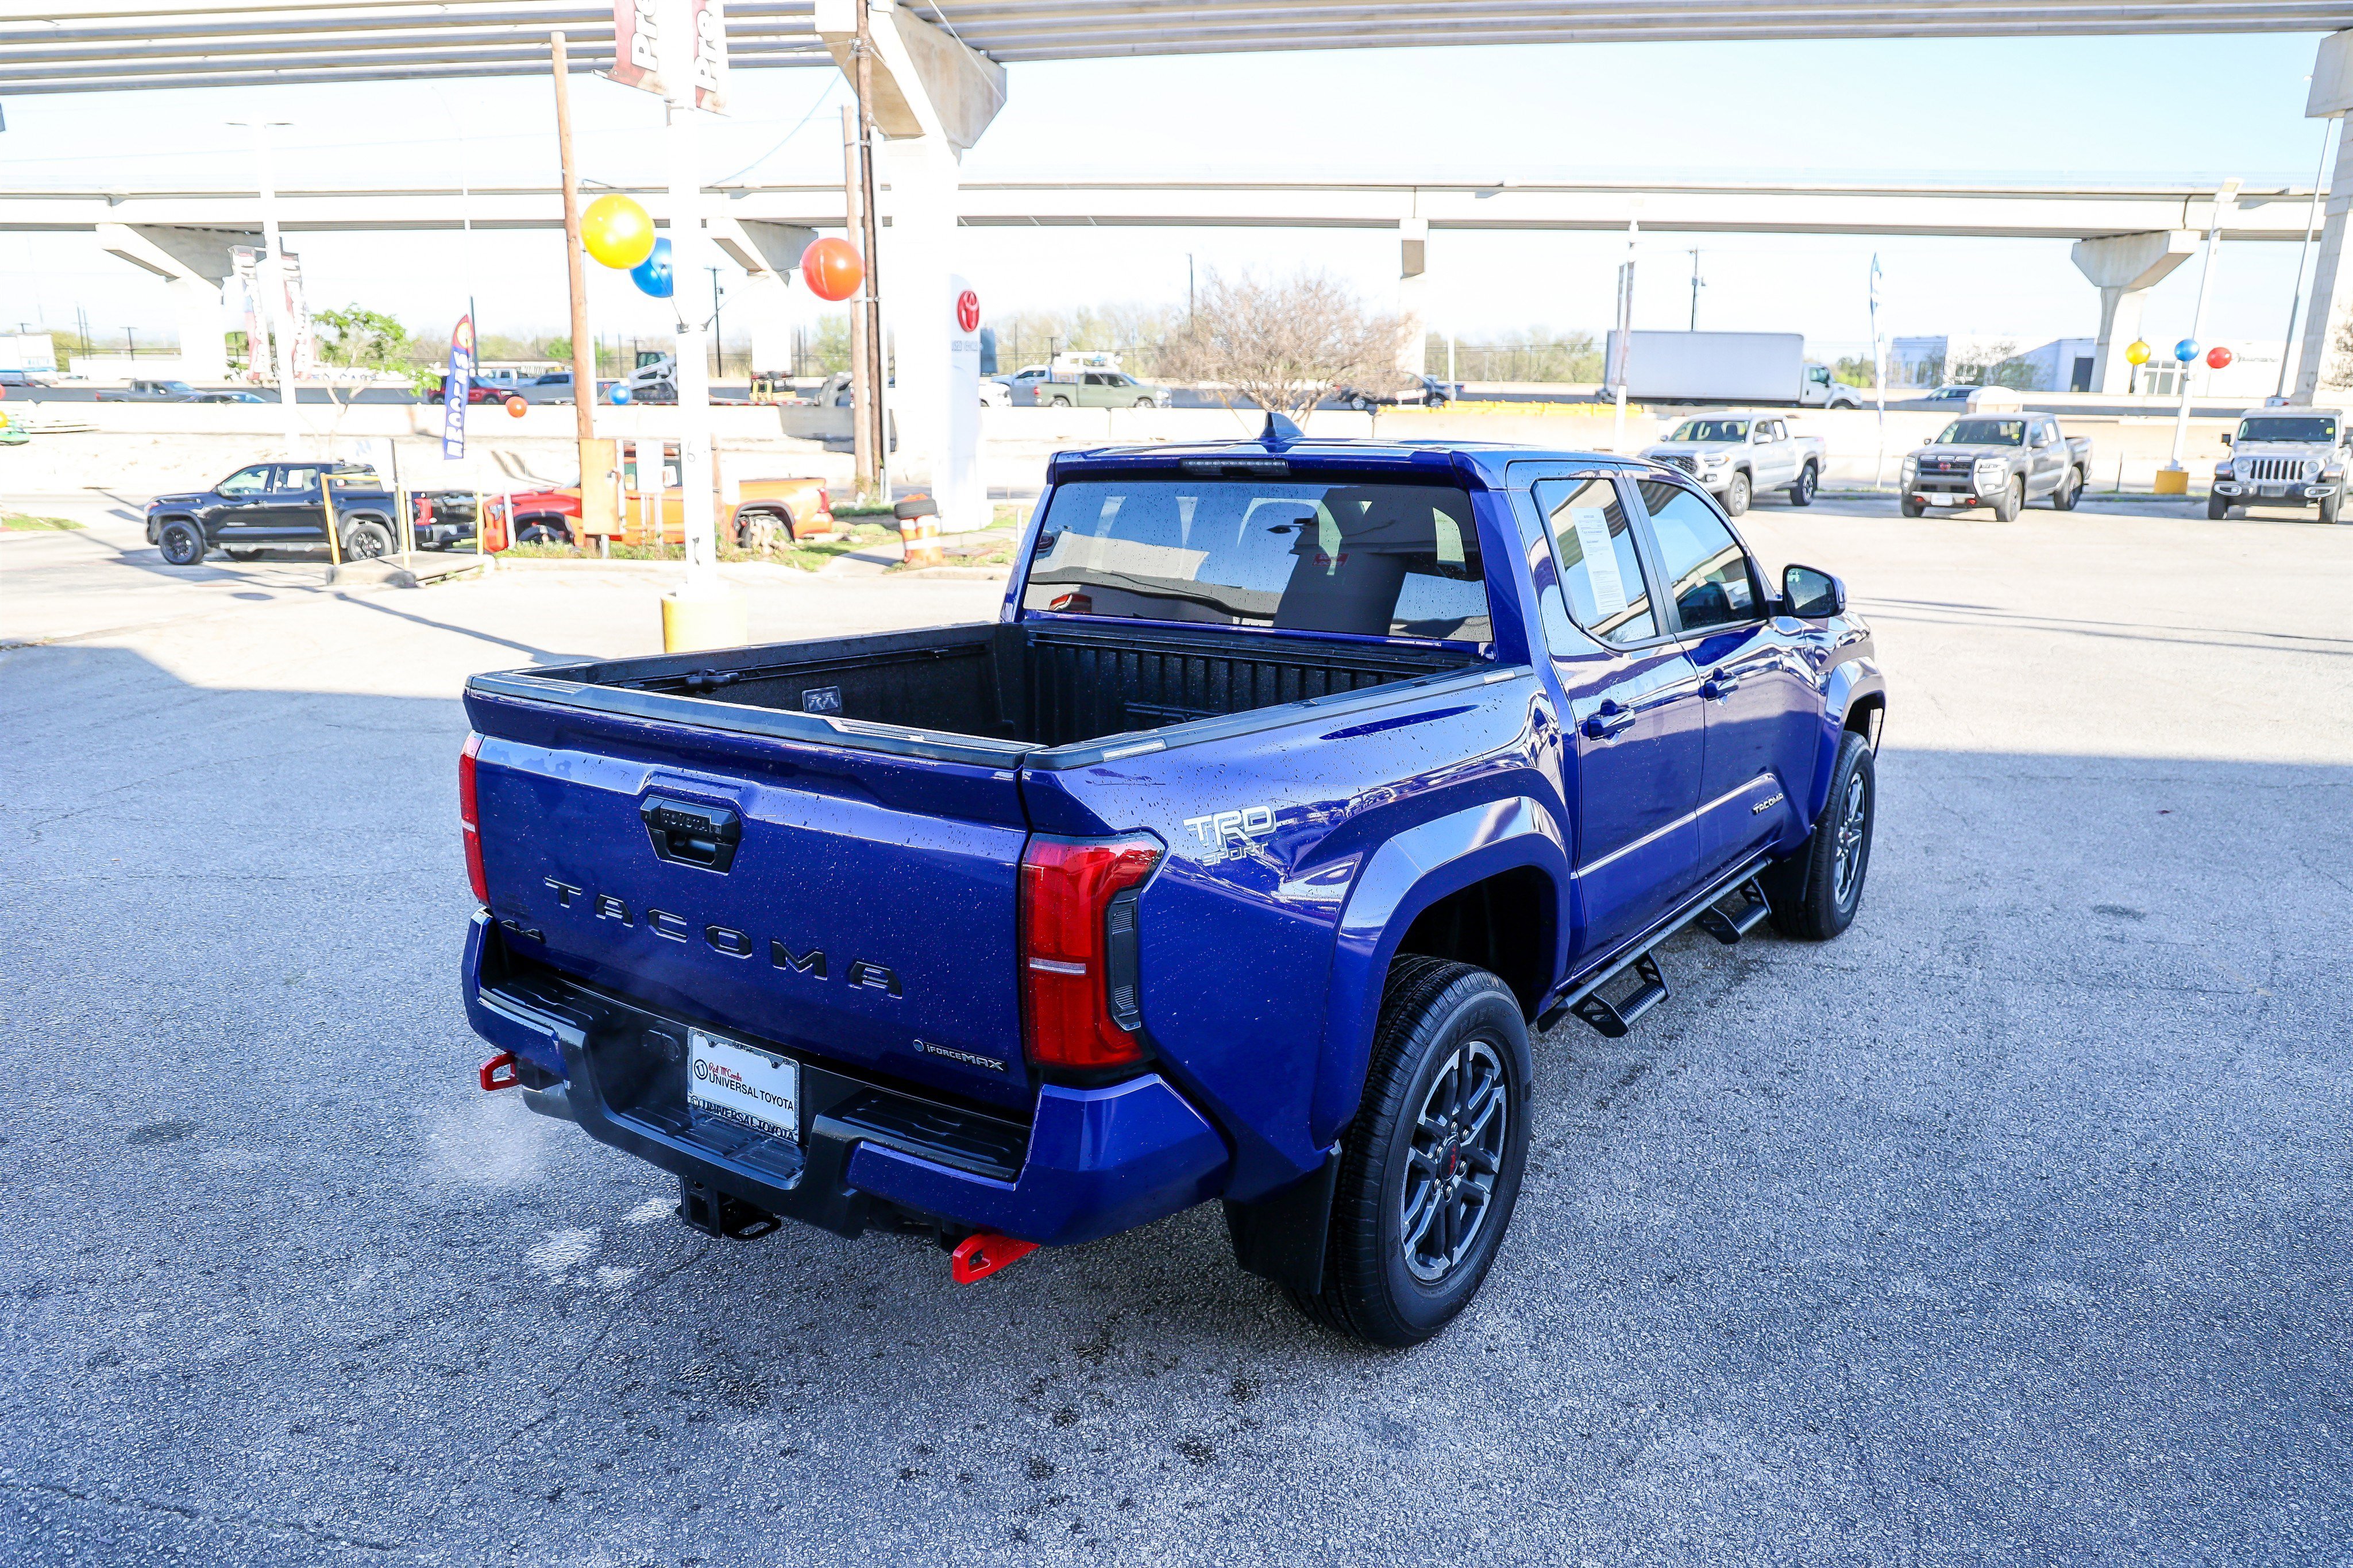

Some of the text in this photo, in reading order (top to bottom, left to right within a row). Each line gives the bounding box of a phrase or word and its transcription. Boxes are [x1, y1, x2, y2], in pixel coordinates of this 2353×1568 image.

[1752, 793, 1784, 814] TACOMA
[662, 812, 708, 832] TOYOTA
[1183, 805, 1276, 850] TRD
[1201, 843, 1269, 866] SPORT
[543, 876, 902, 999] TACOMA
[709, 1072, 794, 1112] UNIVERSAL TOYOTA
